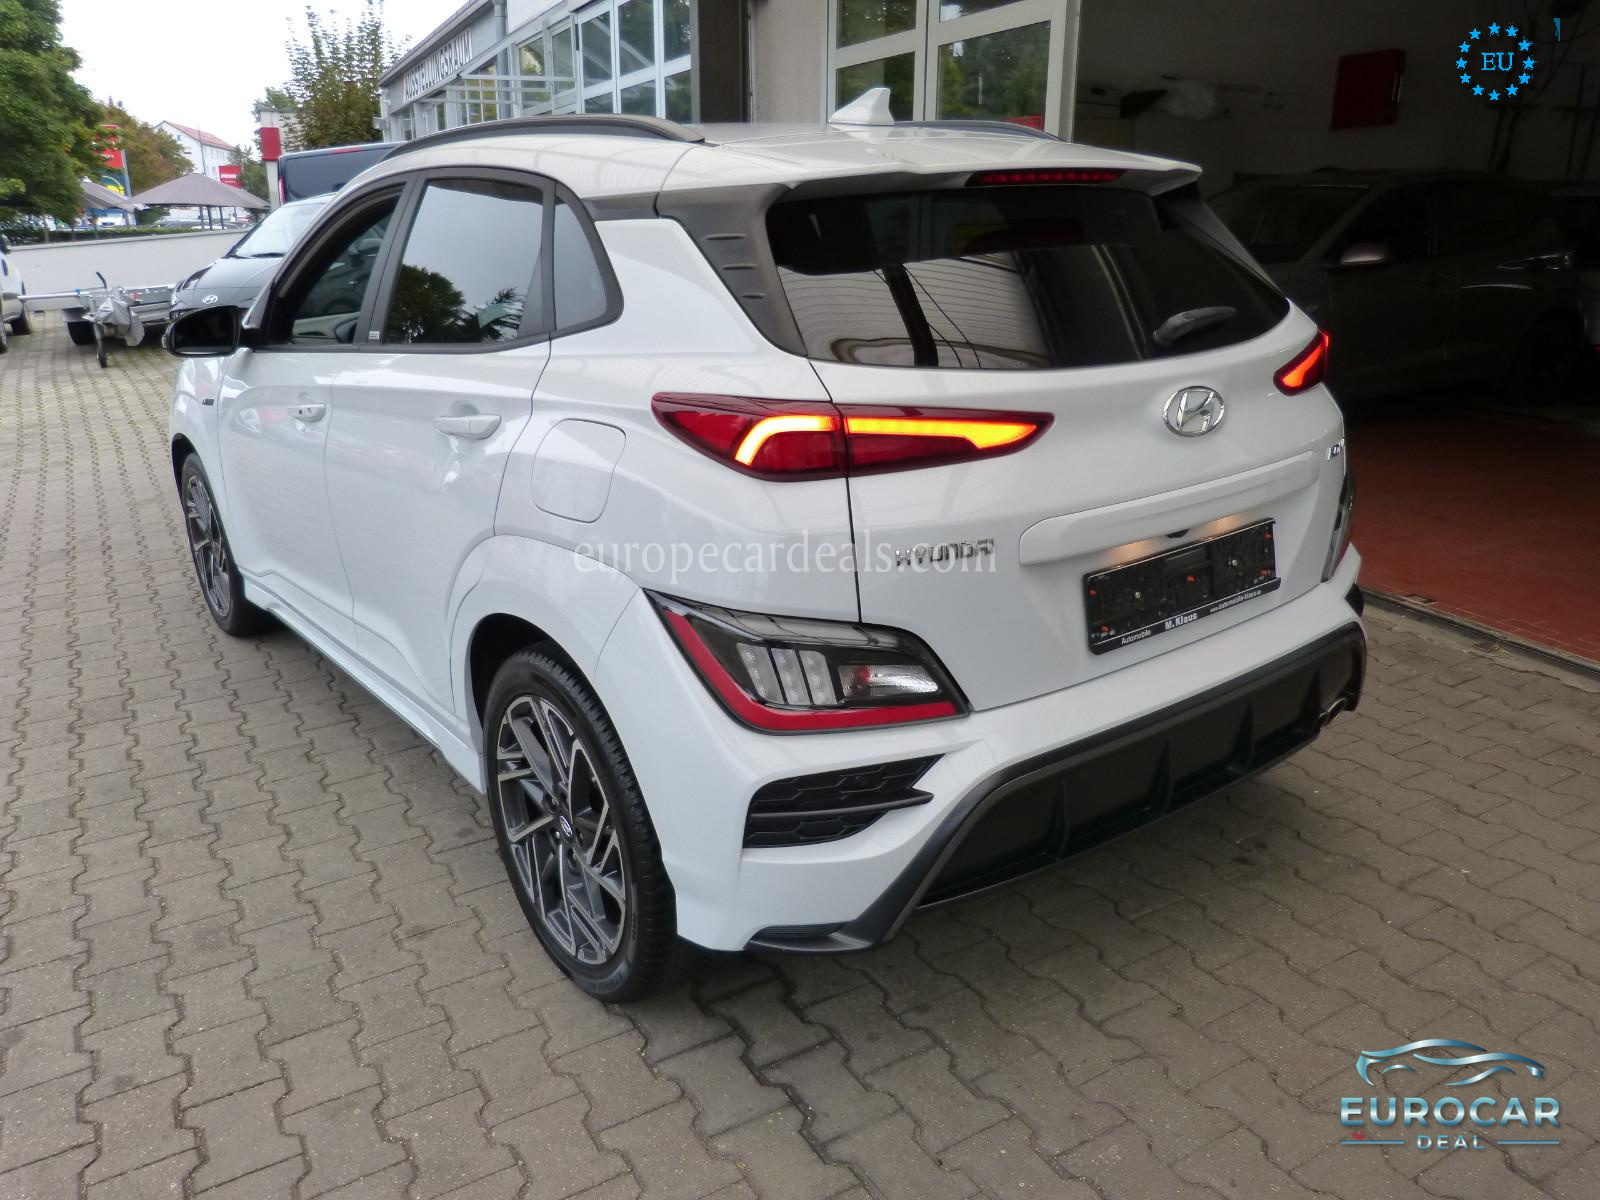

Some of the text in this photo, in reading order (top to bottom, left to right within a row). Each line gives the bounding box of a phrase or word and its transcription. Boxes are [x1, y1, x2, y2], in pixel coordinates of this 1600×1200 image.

[403, 28, 473, 102] AUSSTELLUNGSRAUM
[1121, 629, 1151, 645] Automobile
[1165, 619, 1175, 630] M.
[1175, 611, 1198, 627] Klaus
